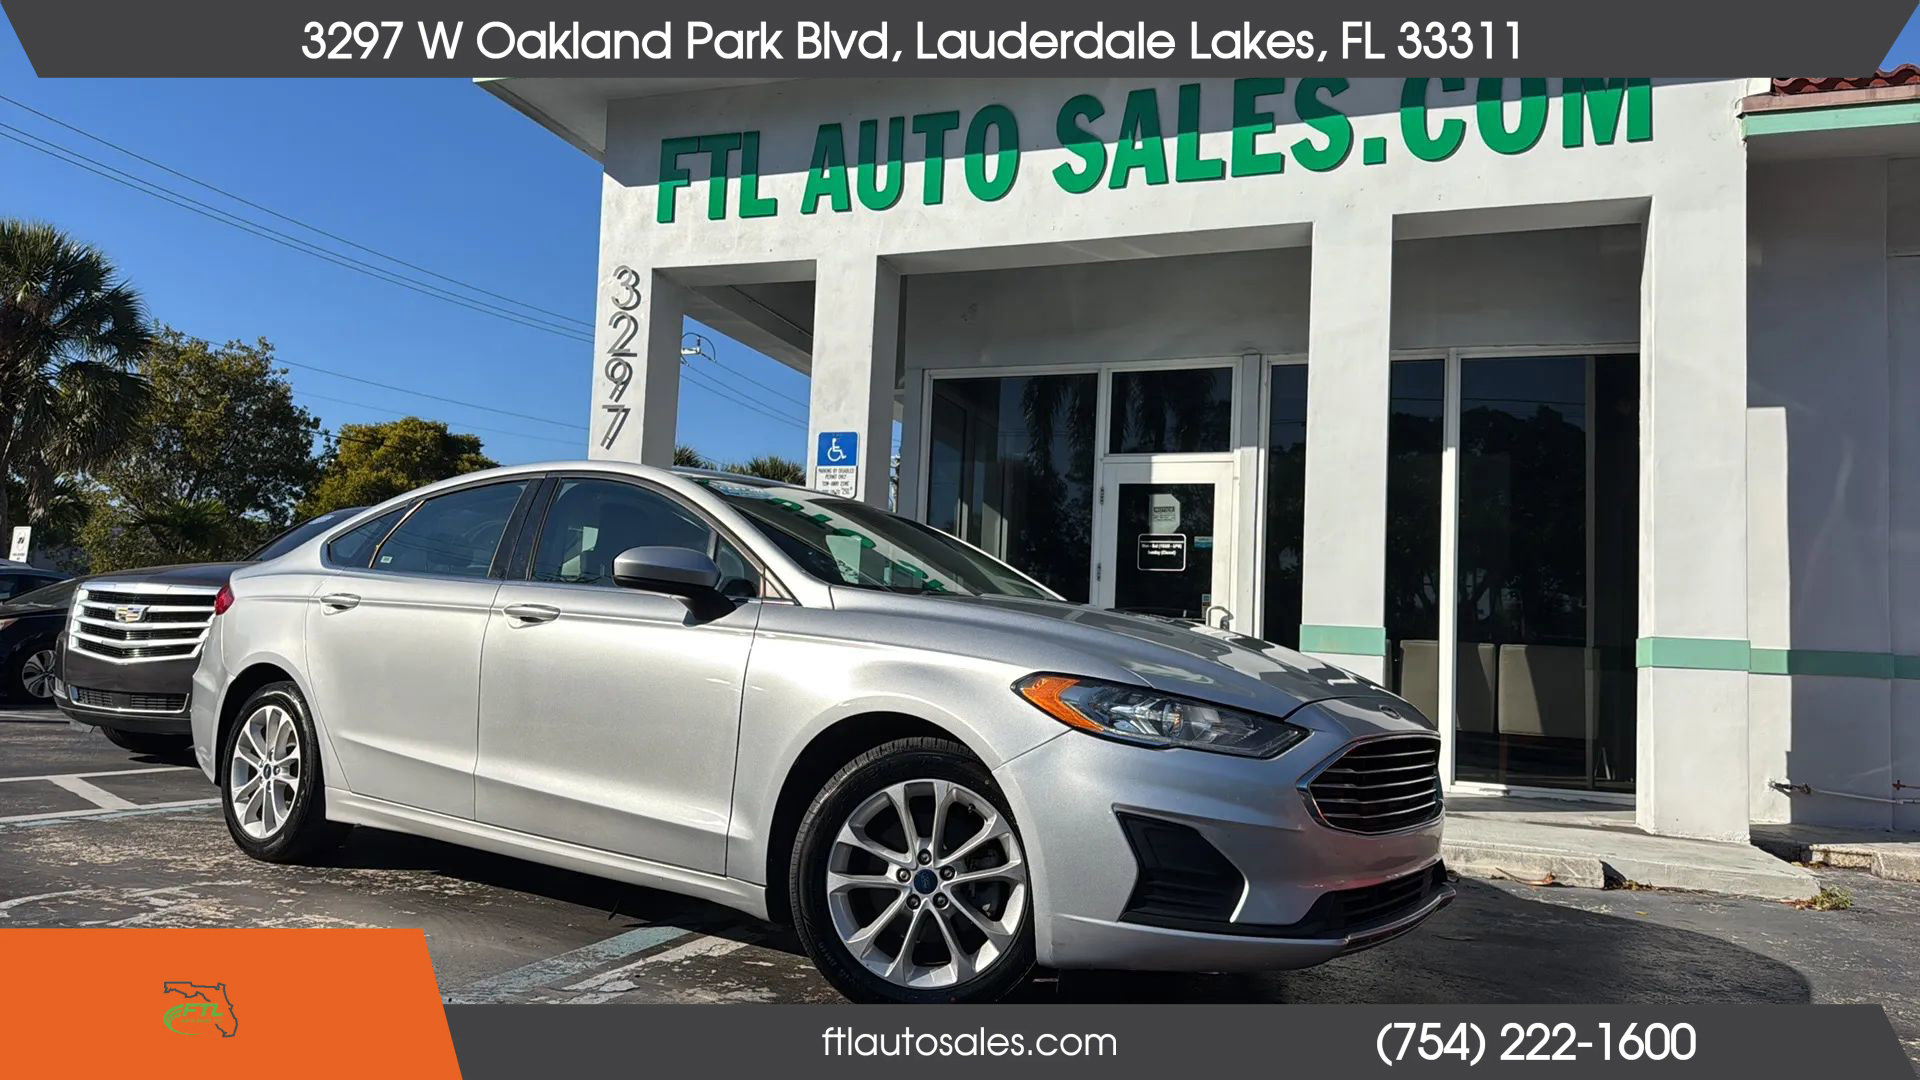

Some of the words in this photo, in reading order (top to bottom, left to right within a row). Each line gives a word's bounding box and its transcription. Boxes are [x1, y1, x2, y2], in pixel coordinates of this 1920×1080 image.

[657, 131, 778, 224] FTL
[800, 103, 1021, 216] AUTO
[1053, 78, 1654, 194] SALES.COM
[600, 264, 641, 450] 3297
